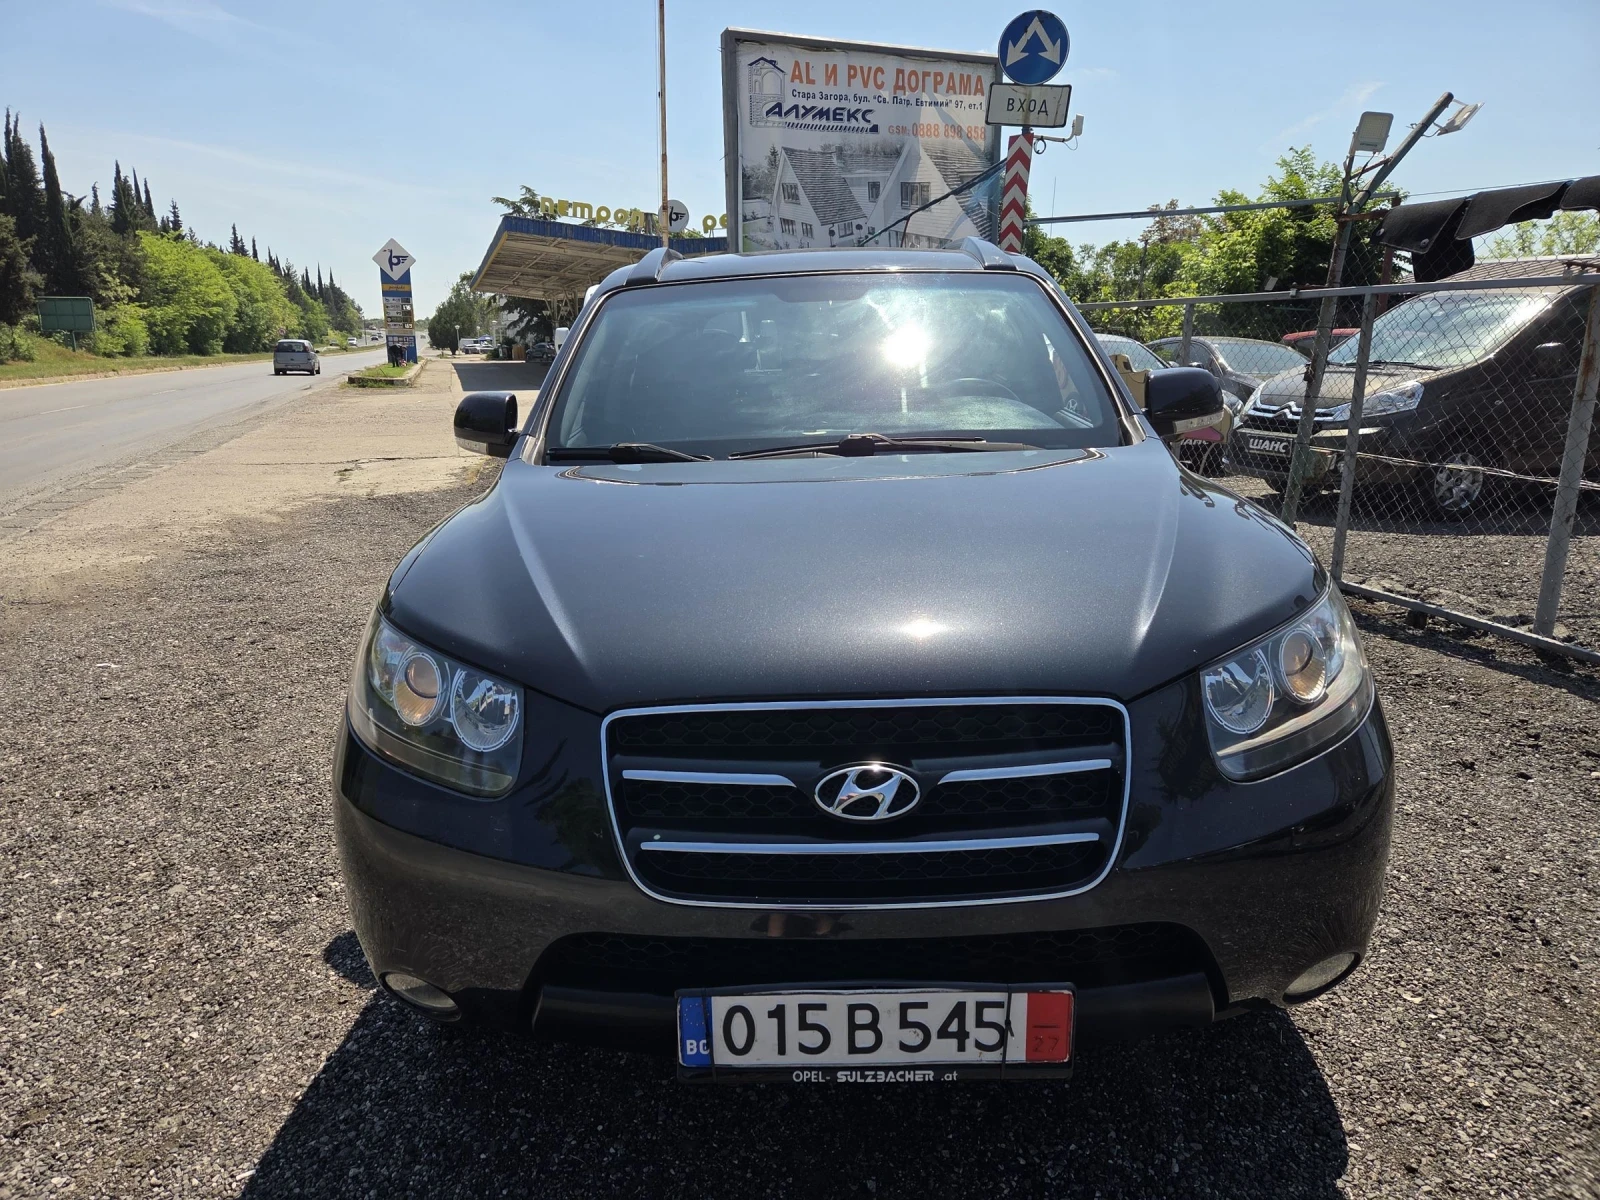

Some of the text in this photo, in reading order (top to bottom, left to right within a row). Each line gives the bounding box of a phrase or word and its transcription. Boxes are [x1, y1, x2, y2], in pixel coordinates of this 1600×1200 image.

[790, 60, 985, 97] AL И PVC ДОГРАМА
[791, 88, 816, 101] Стара
[818, 91, 851, 103] Загора,
[853, 94, 871, 105] бул.
[892, 96, 913, 107] Патр.
[954, 100, 966, 111] 97,
[1006, 98, 1048, 116] ВХОД
[765, 101, 876, 124] АЛУМЕКС
[887, 122, 987, 141] GSM: 0888 898 858
[1248, 438, 1289, 453] ШАНС
[836, 1070, 935, 1083] SULZBACHER
